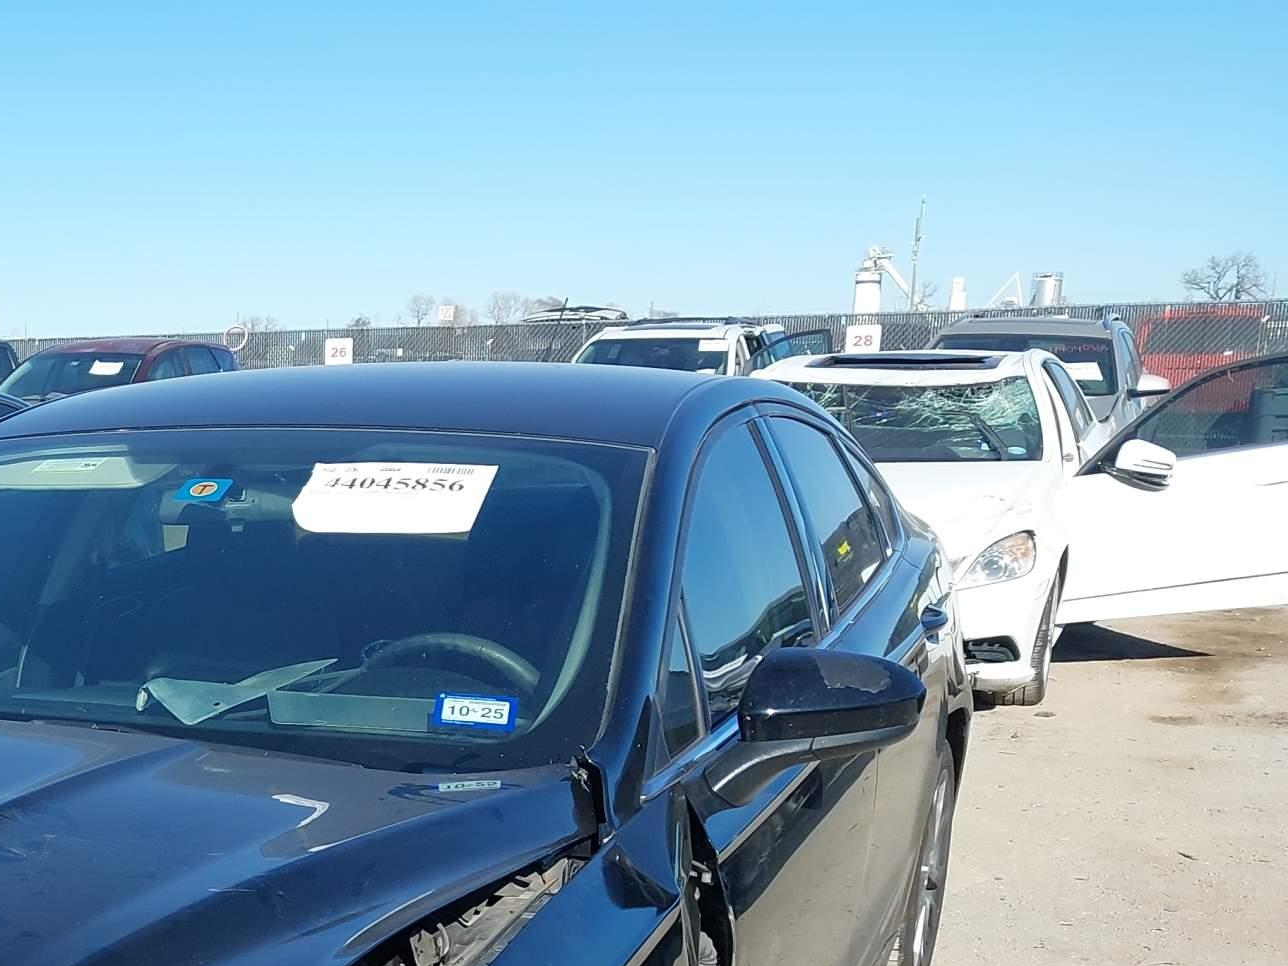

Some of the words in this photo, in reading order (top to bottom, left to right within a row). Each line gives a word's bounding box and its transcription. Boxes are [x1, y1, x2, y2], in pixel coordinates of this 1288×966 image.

[852, 334, 873, 347] 28
[330, 347, 347, 358] 26
[324, 476, 465, 492] 44045856
